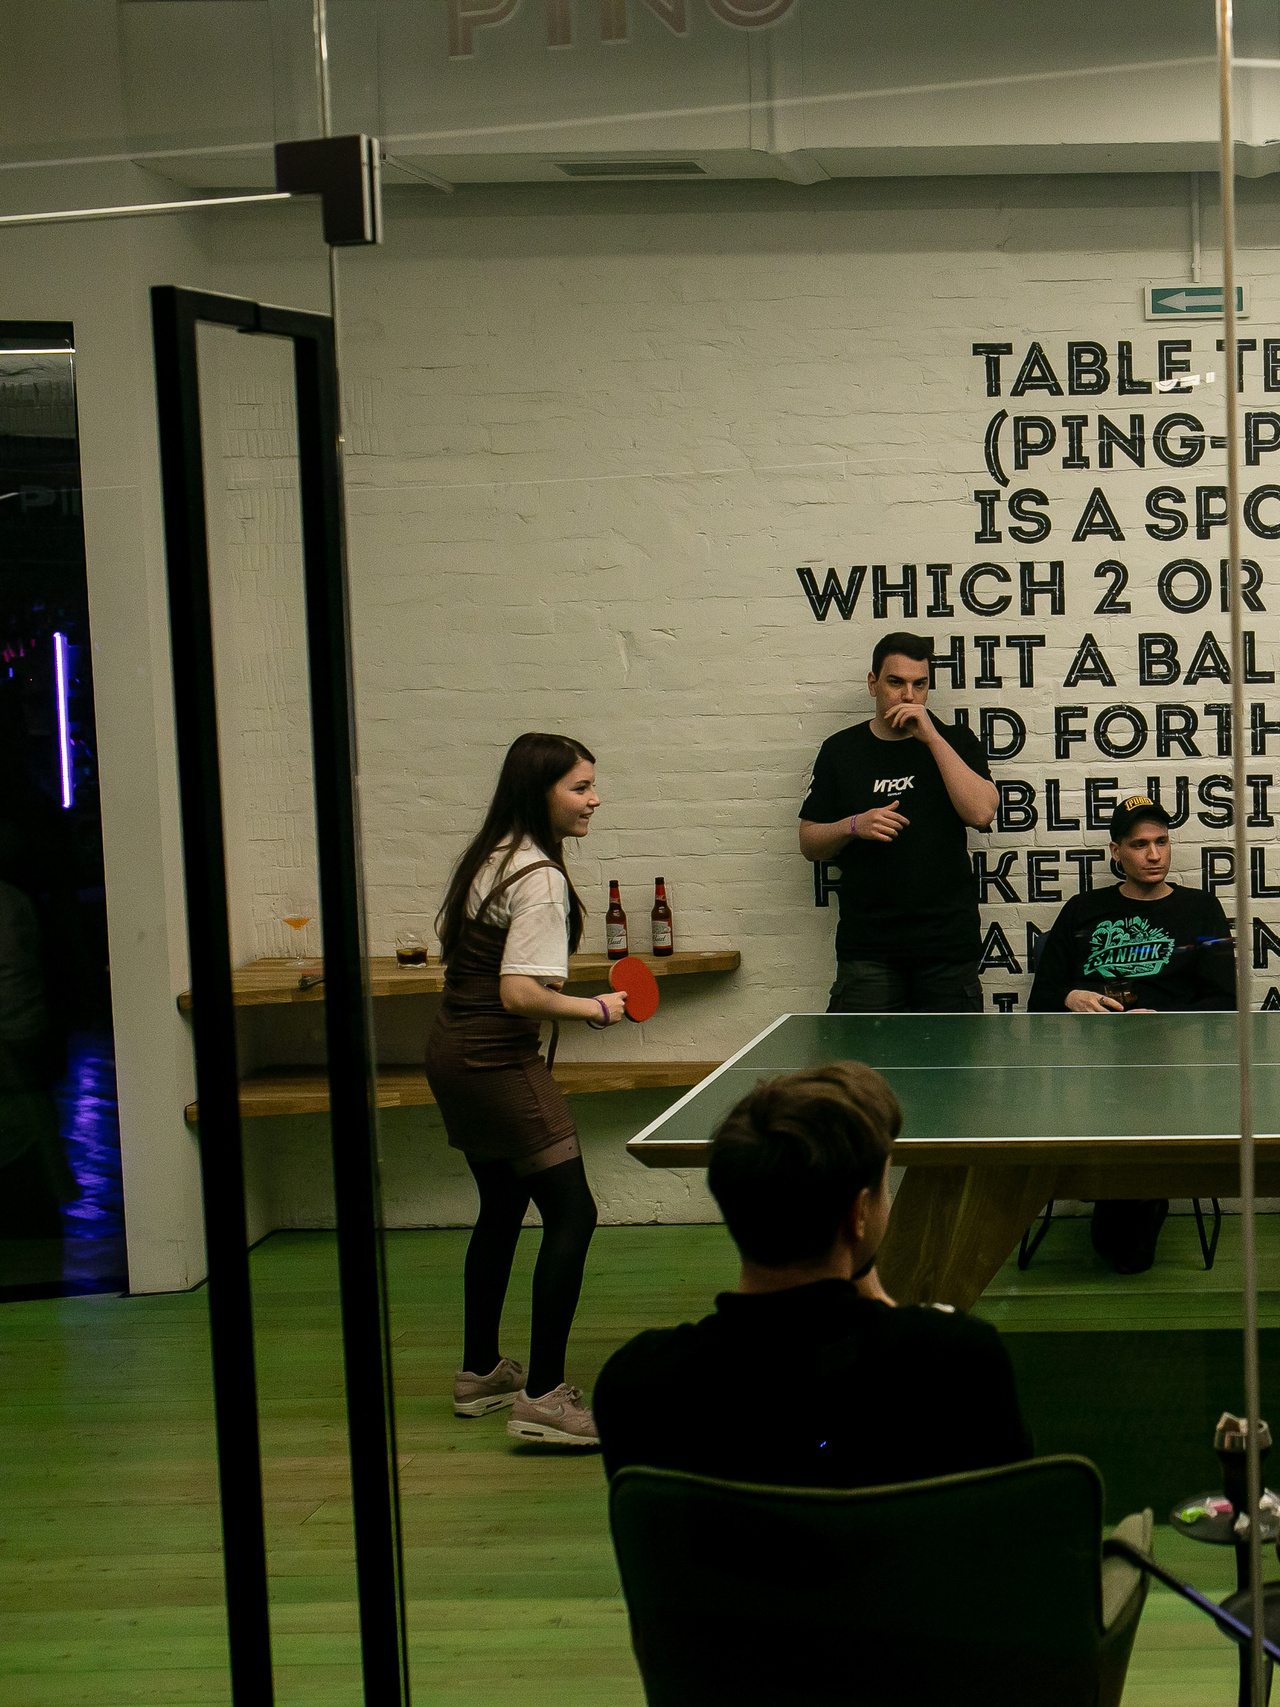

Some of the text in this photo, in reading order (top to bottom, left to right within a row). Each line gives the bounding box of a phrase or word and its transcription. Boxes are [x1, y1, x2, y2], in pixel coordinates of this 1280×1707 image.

[972, 339, 1193, 397] TABLE
[974, 487, 1053, 544] IS
[1072, 487, 1126, 543] A
[796, 559, 1066, 622] WHICH
[1093, 558, 1132, 615] 2
[1157, 557, 1268, 615] OR
[928, 634, 1046, 690] HIT
[1063, 632, 1117, 689] A
[974, 776, 1119, 834] BLE
[1093, 943, 1162, 967] SANHOK
